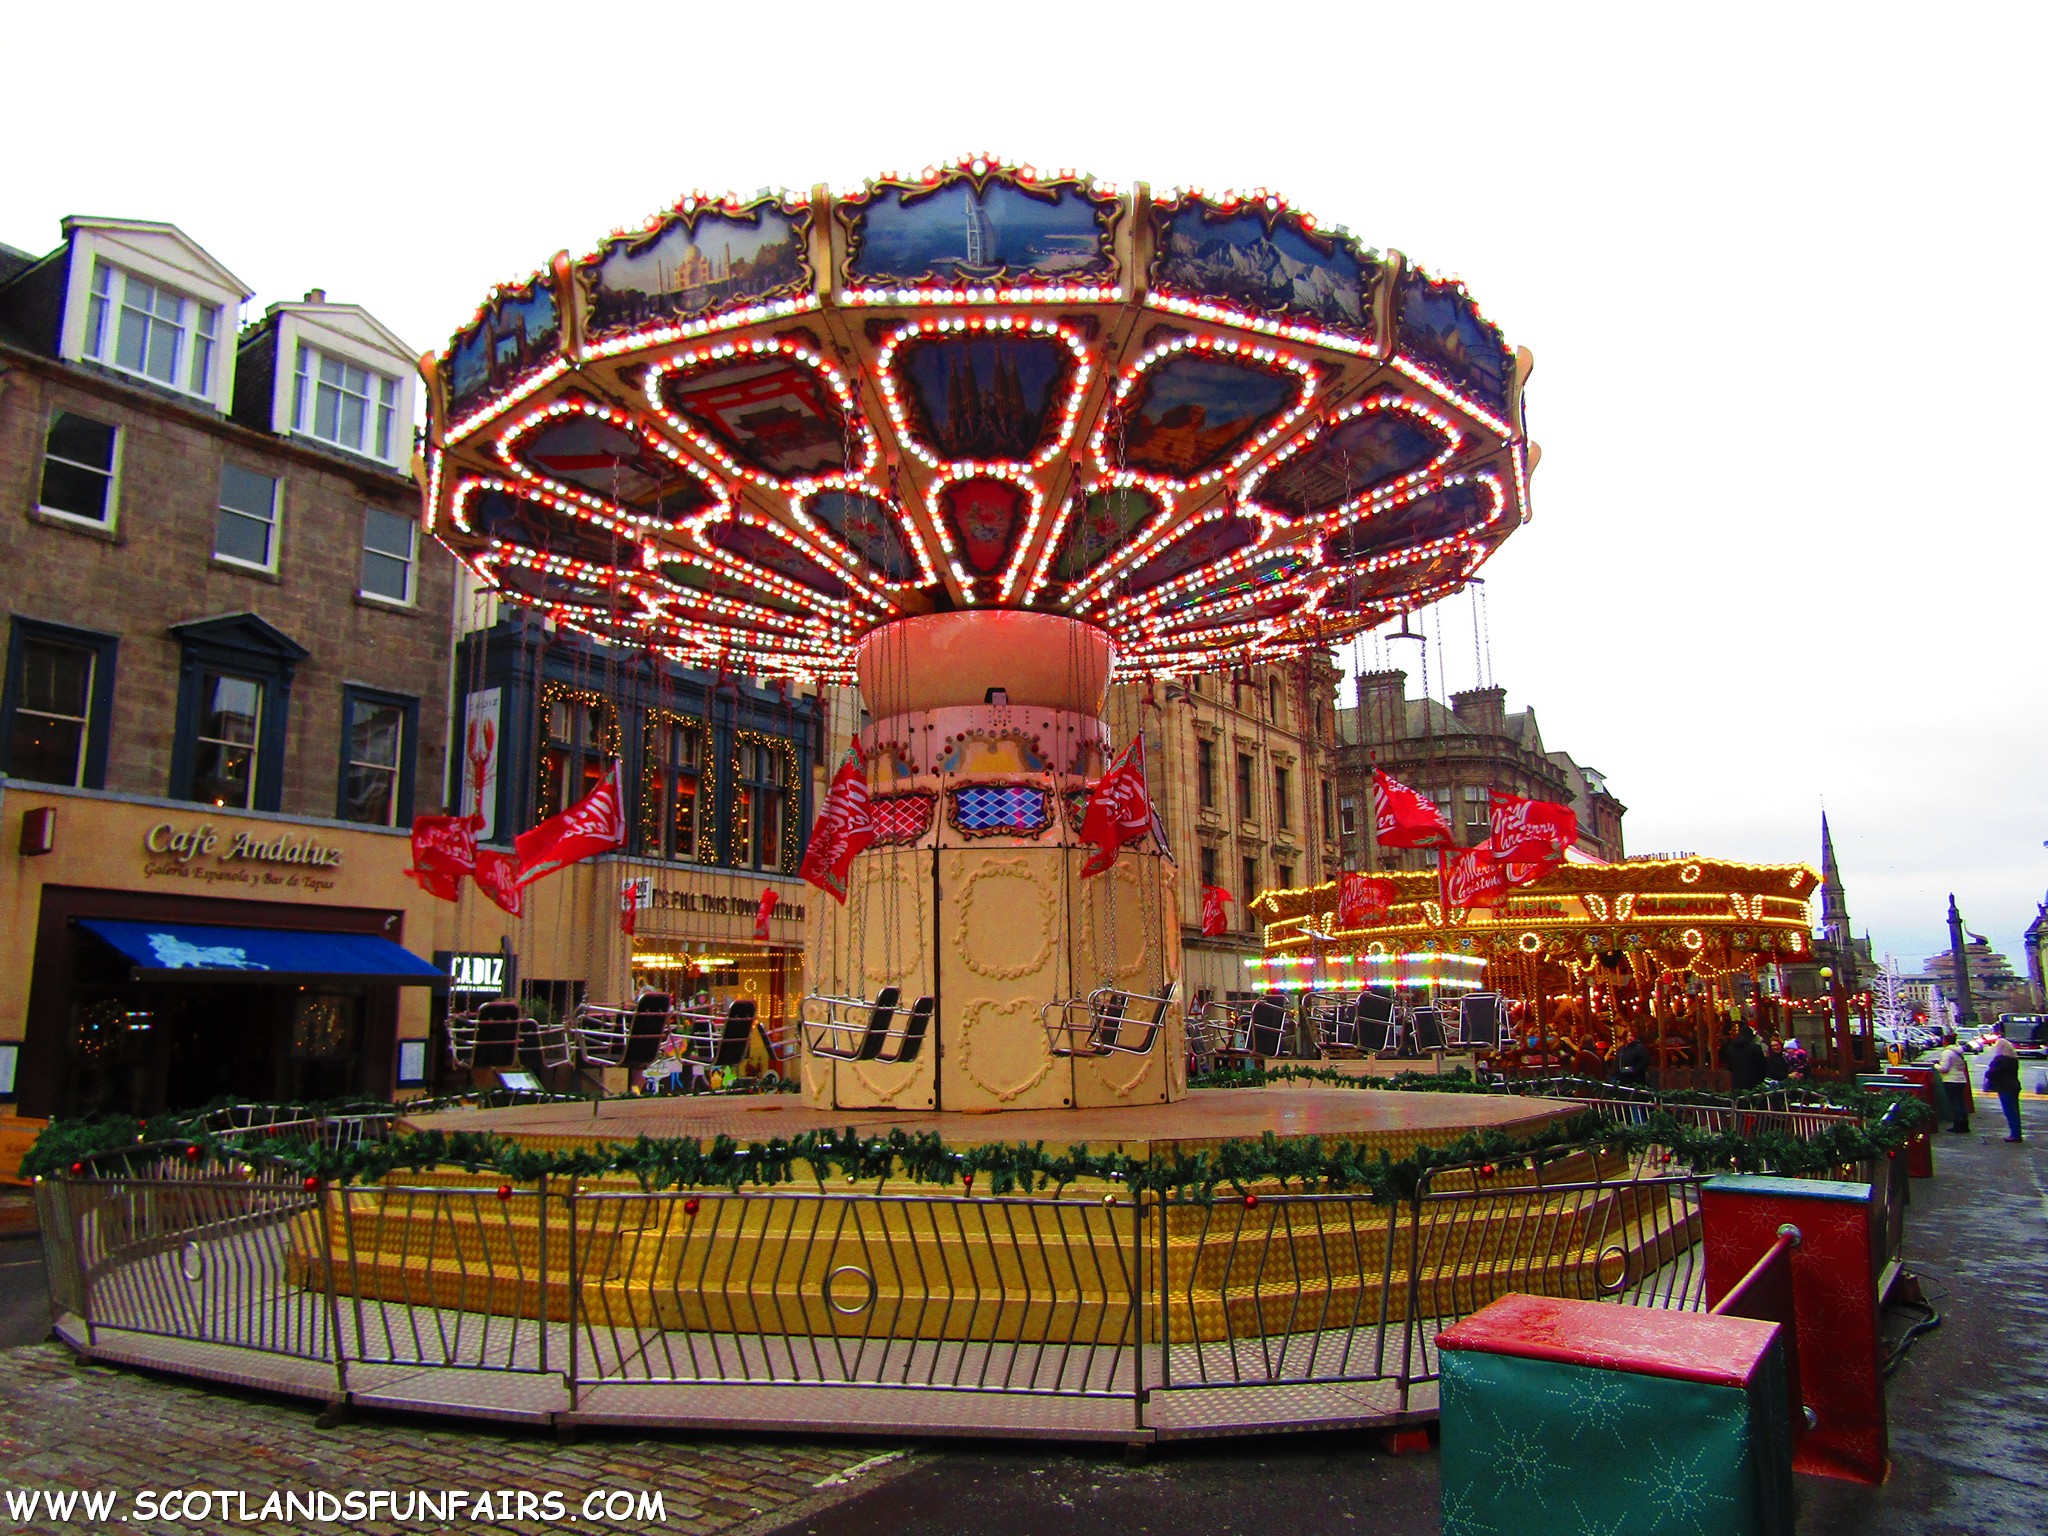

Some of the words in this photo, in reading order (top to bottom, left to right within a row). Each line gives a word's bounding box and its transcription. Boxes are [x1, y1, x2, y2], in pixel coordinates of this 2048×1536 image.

[145, 823, 218, 862] Café
[219, 831, 343, 866] Andaluz
[301, 876, 335, 892] Tapas
[702, 894, 727, 915] THIS
[451, 956, 503, 985] CADIZ
